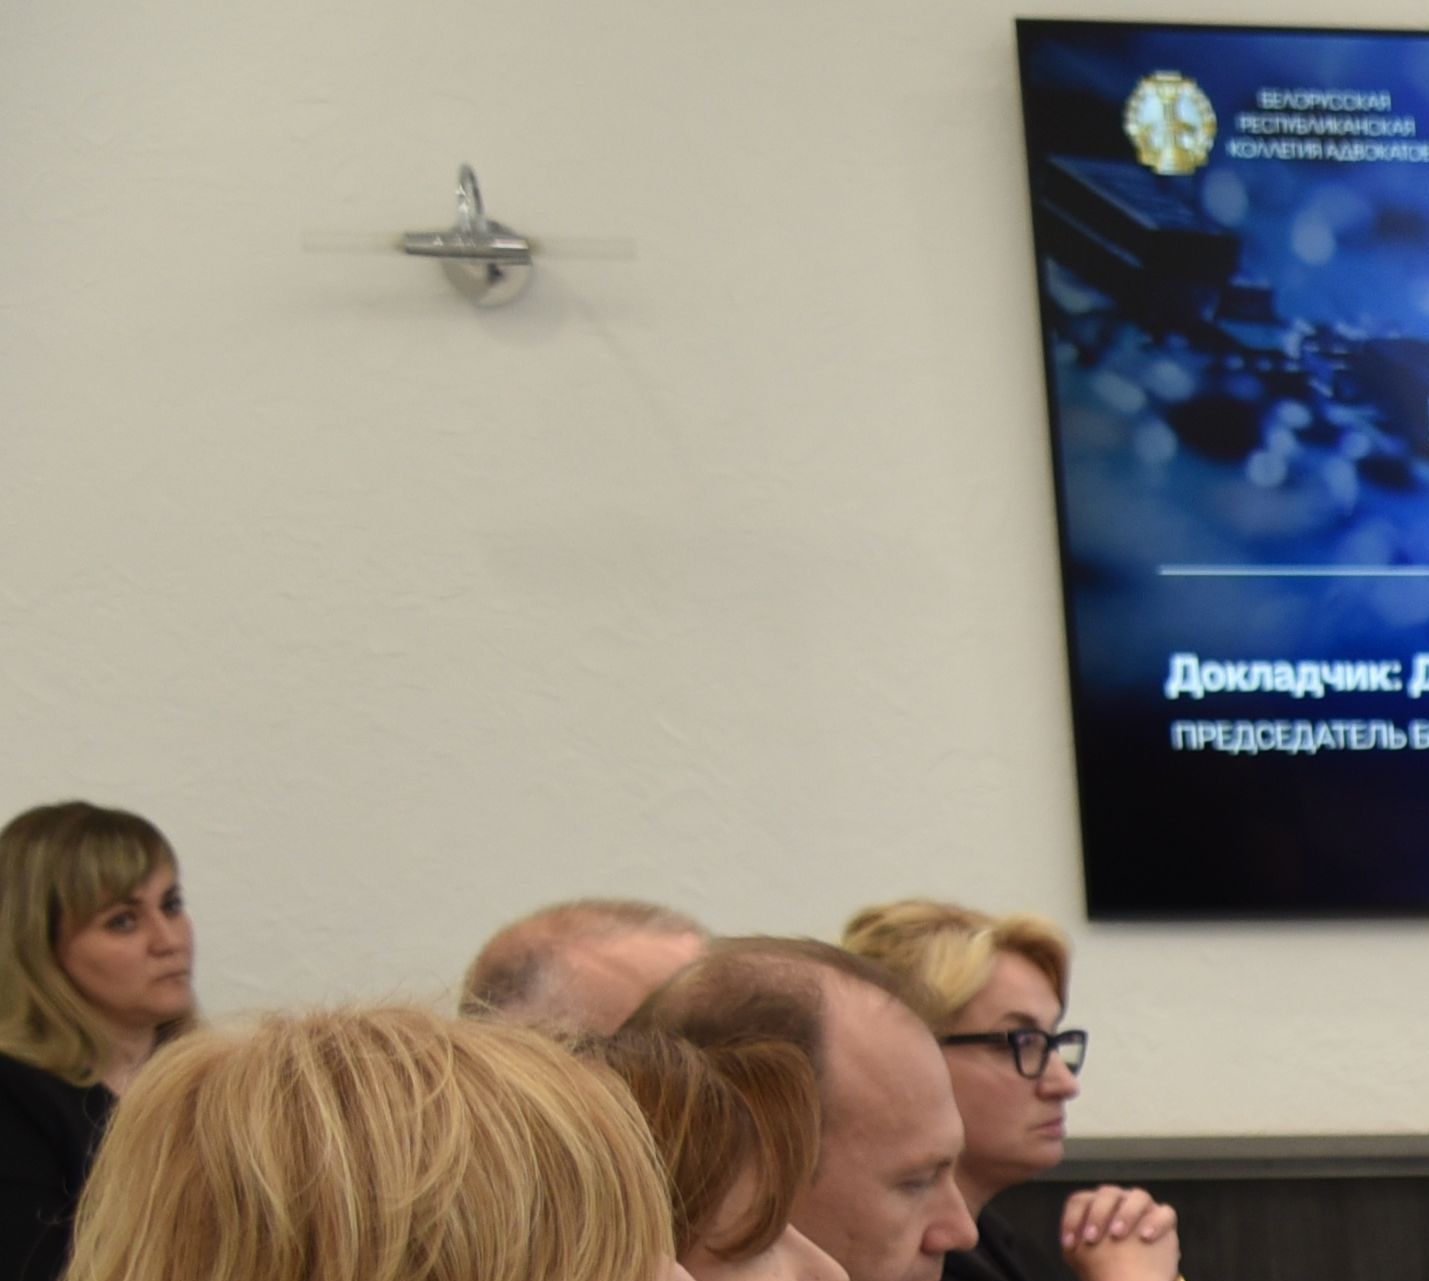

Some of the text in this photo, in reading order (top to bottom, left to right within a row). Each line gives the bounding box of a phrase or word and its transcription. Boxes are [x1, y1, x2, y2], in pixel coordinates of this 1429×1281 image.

[1257, 89, 1392, 112] БЕЛОРУССКАЯ
[1236, 112, 1416, 137] РЕСПУБЛИКАНСКАЯ
[1227, 137, 1322, 159] КОЛЛЕГИЯ
[1165, 652, 1402, 699] Докладчик:
[1171, 719, 1408, 756] ПРЕДСЕДАТЕЛЬ
